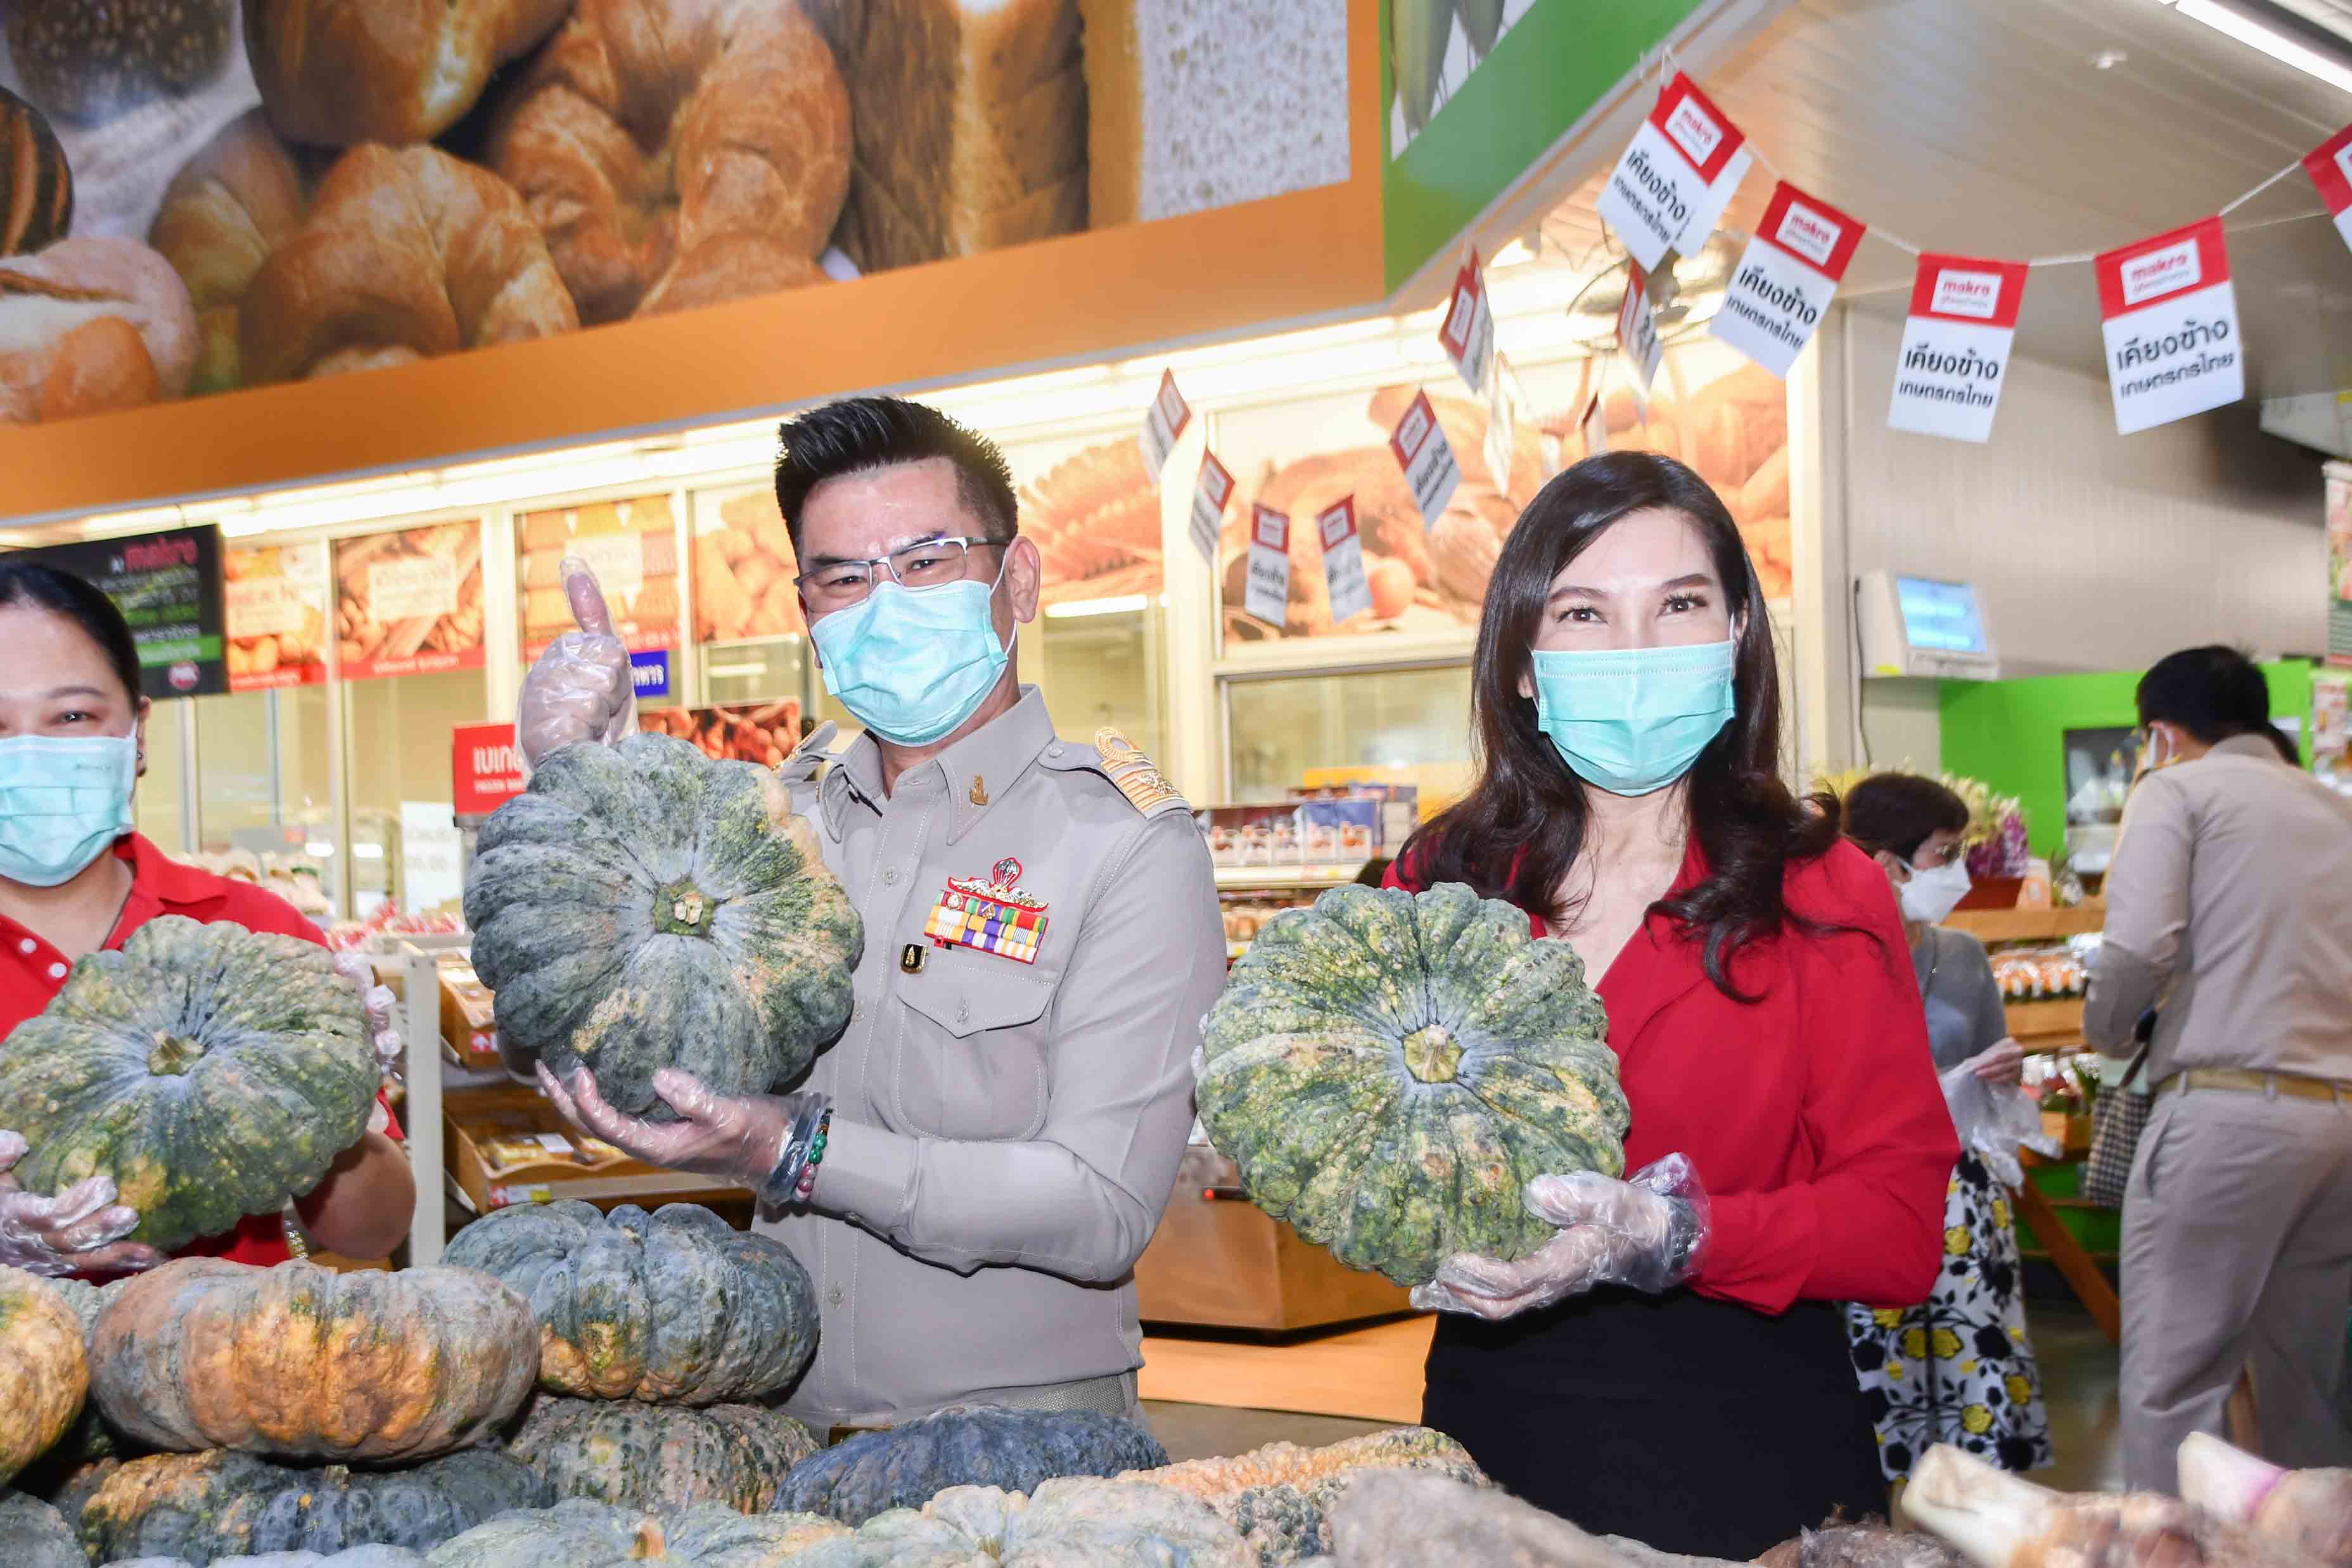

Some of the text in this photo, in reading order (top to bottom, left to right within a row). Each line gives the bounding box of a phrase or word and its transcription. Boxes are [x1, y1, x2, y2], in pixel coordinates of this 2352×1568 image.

[1627, 150, 1686, 220] เคียงข้าง
[1791, 215, 1830, 244] makro
[2132, 253, 2188, 281] makro
[1739, 265, 1817, 325] เคียงข้าง
[1943, 280, 1991, 295] makro
[1905, 342, 1999, 380] เคียงข้าง
[2116, 318, 2229, 371] เคียงข้าง
[1899, 380, 1993, 407] เกษตรกรไทย
[2120, 352, 2234, 398] เกษตรกรไทย
